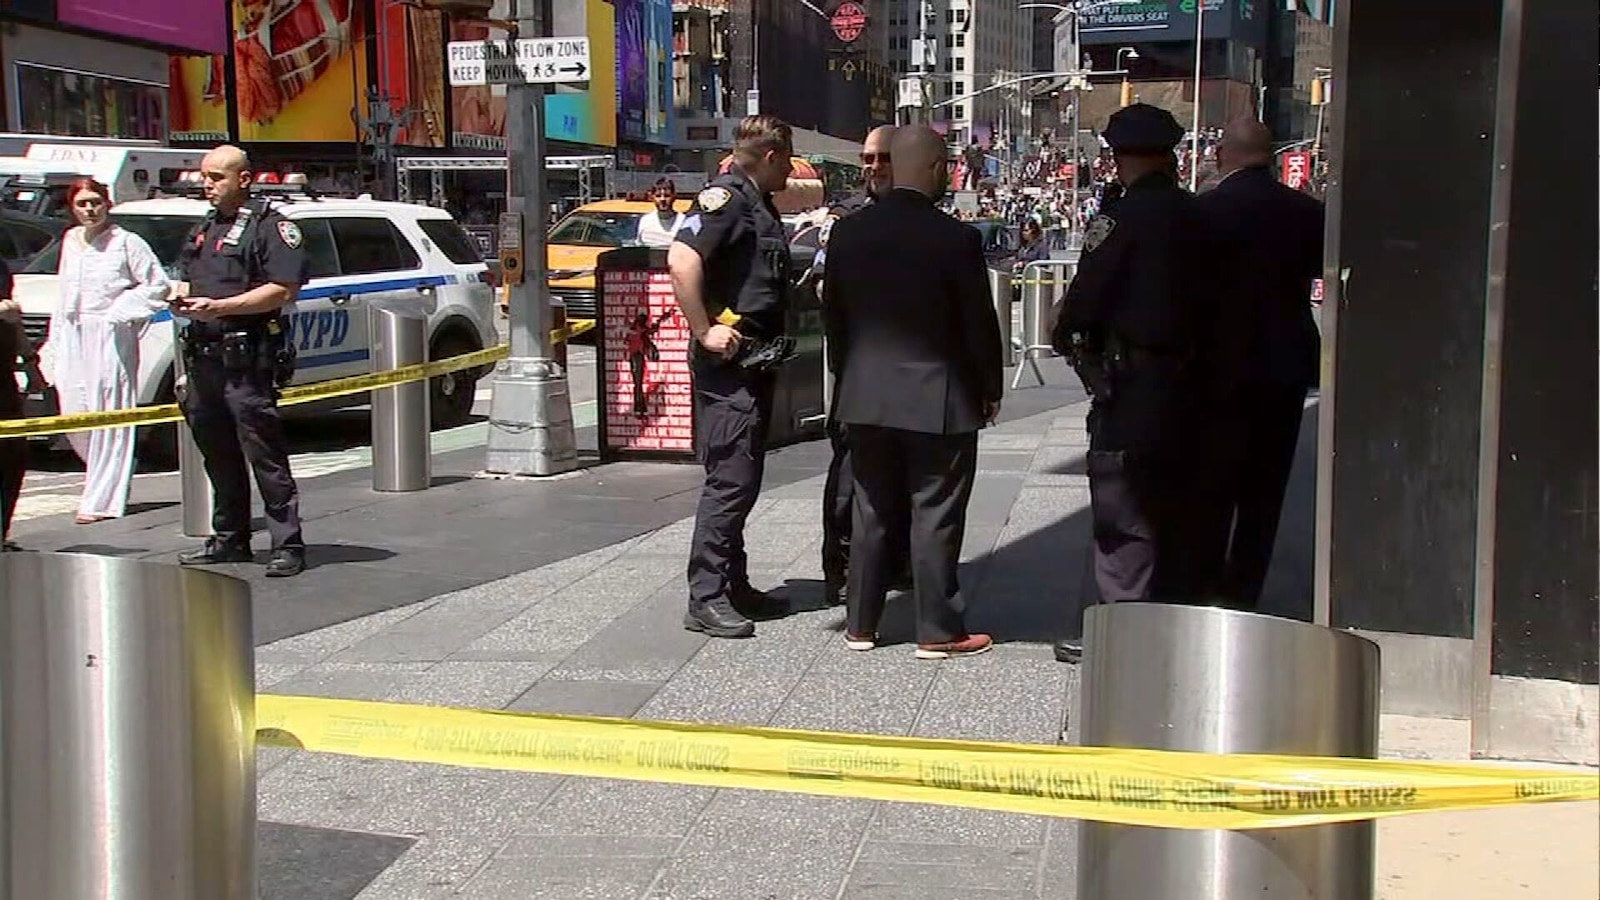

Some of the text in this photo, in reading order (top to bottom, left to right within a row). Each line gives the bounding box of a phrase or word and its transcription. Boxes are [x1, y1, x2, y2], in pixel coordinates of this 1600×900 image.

[1102, 5, 1120, 14] PUT
[1089, 15, 1106, 23] THE
[1146, 12, 1168, 21] SEAT
[452, 41, 586, 61] PEDESTRIAN FLOW ZONE
[453, 64, 527, 80] KEEP MOVING
[1288, 155, 1305, 188] tkts
[604, 283, 643, 293] SMOOTH
